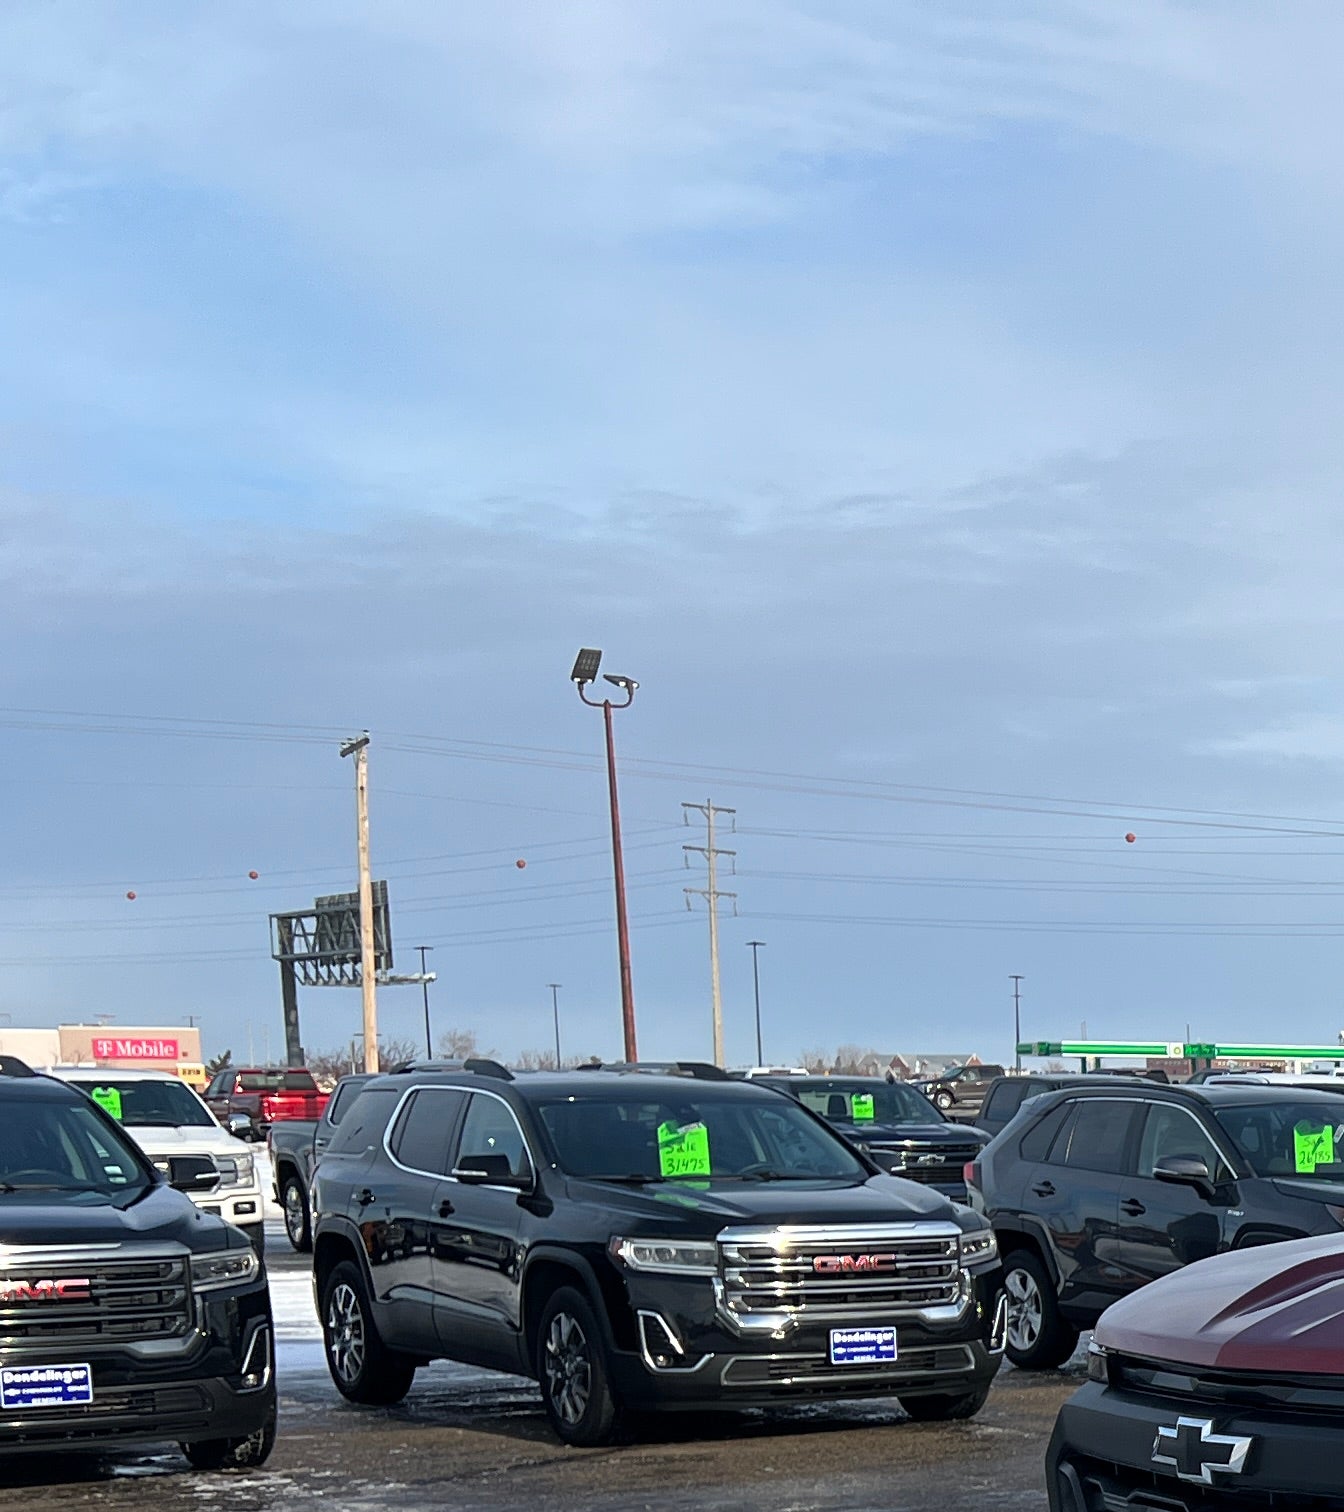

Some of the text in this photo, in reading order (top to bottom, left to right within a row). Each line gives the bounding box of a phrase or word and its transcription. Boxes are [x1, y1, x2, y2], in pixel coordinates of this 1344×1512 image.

[115, 1040, 175, 1057] Mobile
[665, 1158, 705, 1175] 31475
[813, 1253, 896, 1273] GMC
